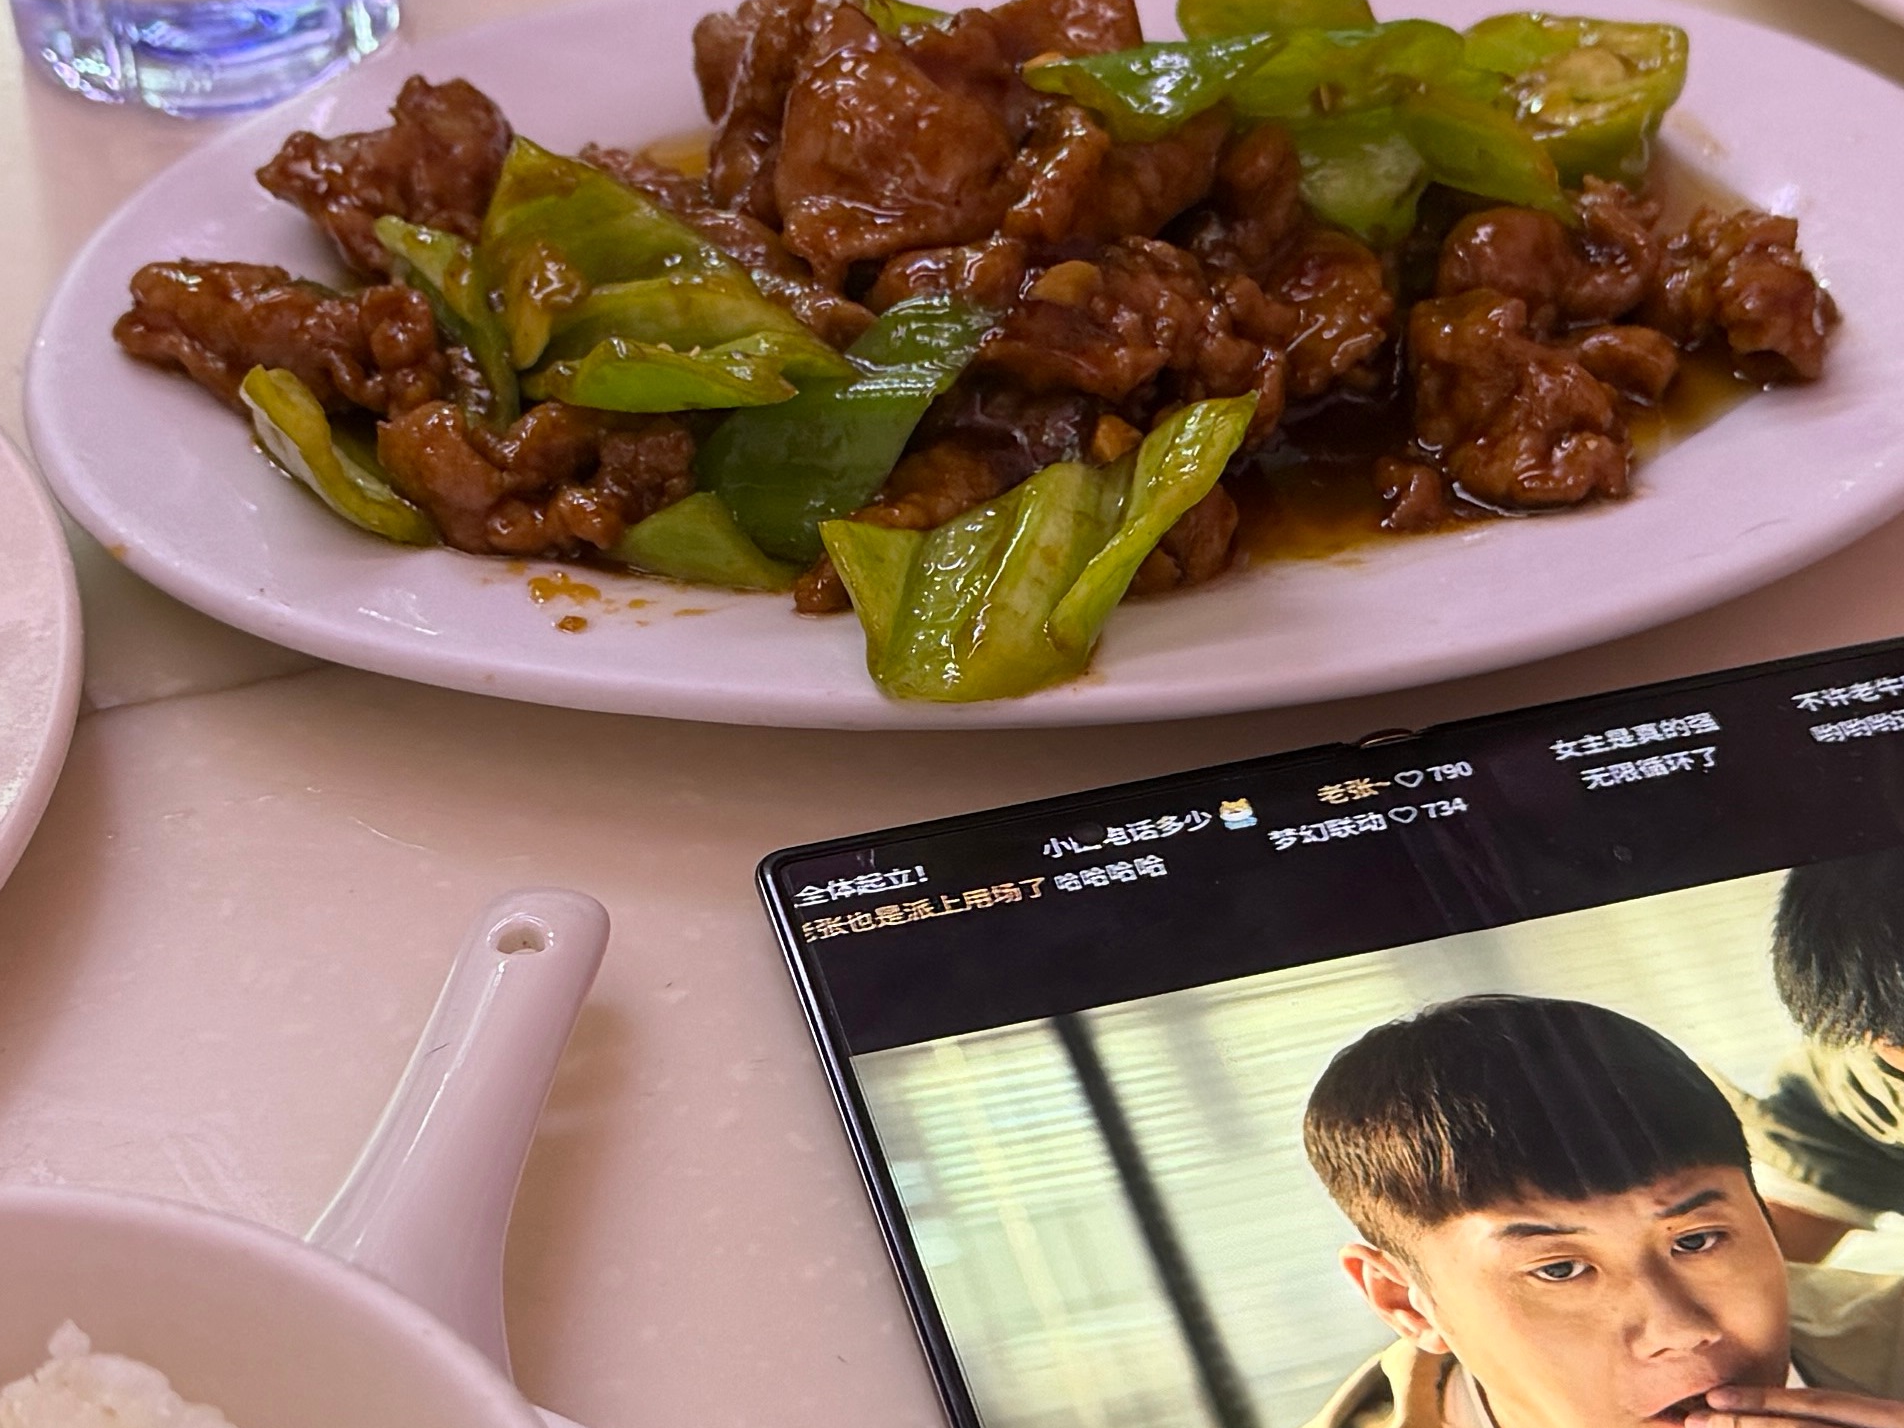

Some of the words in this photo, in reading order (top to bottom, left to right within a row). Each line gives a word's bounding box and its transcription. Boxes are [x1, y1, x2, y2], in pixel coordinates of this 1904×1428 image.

[1549, 713, 1721, 760] 女主是真的强
[1430, 761, 1473, 782] 790
[1581, 747, 1716, 789] 无限循环了
[1042, 810, 1213, 859] 小电话多少
[1267, 811, 1388, 850] 梦幻联动
[1425, 797, 1468, 819] 734
[1053, 854, 1168, 892] 哈哈哈哈
